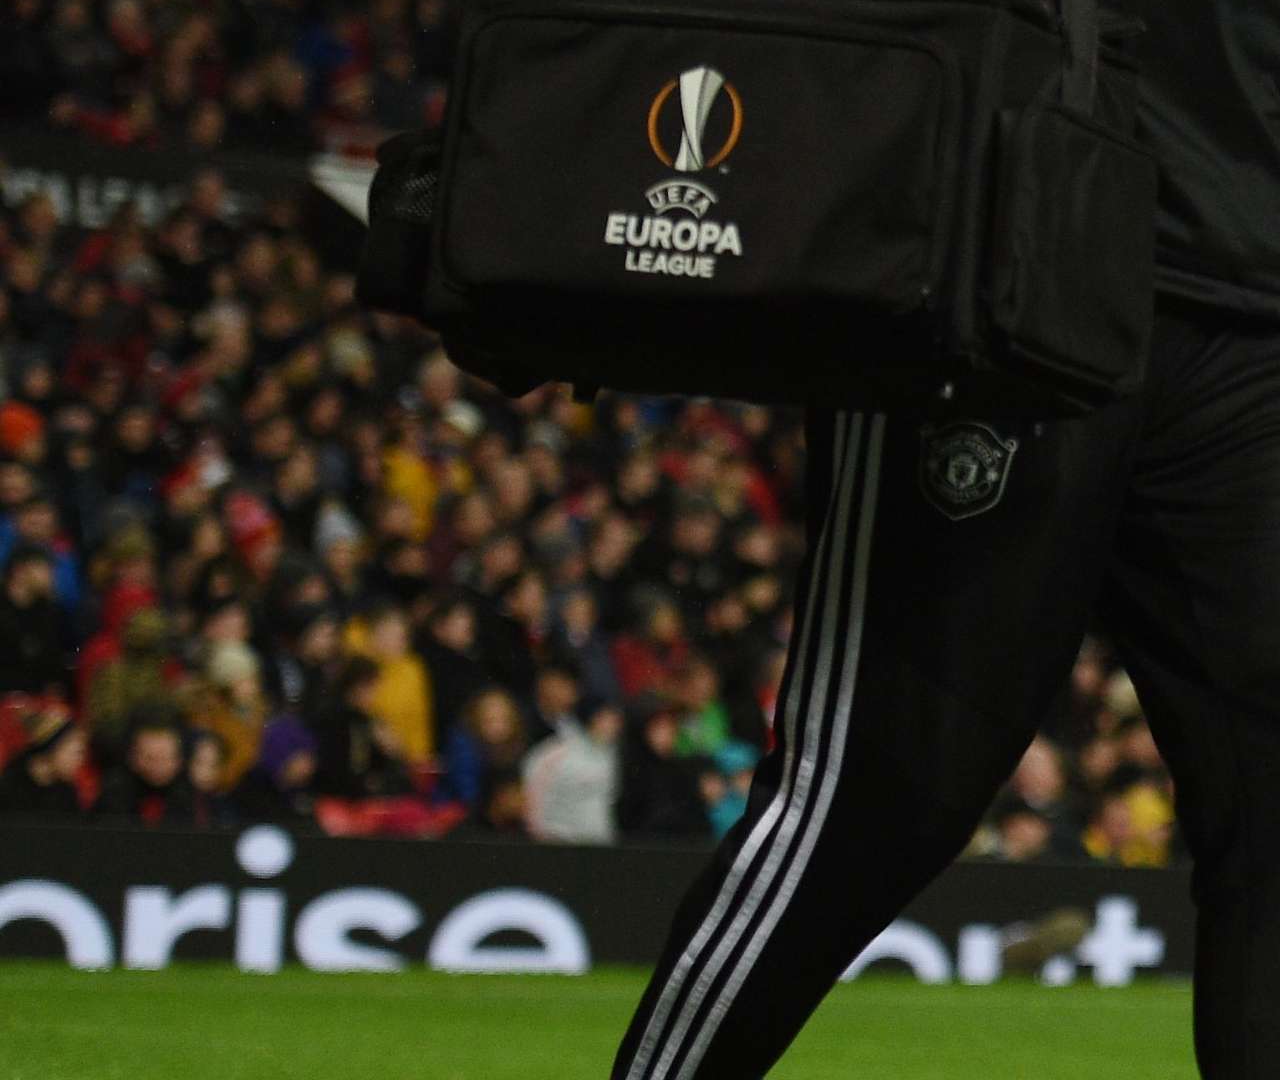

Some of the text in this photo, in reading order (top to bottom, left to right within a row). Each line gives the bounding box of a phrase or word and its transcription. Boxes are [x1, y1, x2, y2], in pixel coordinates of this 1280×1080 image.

[646, 181, 713, 218] UEFA
[604, 212, 743, 257] EUROPA
[624, 248, 716, 279] LEAGUE
